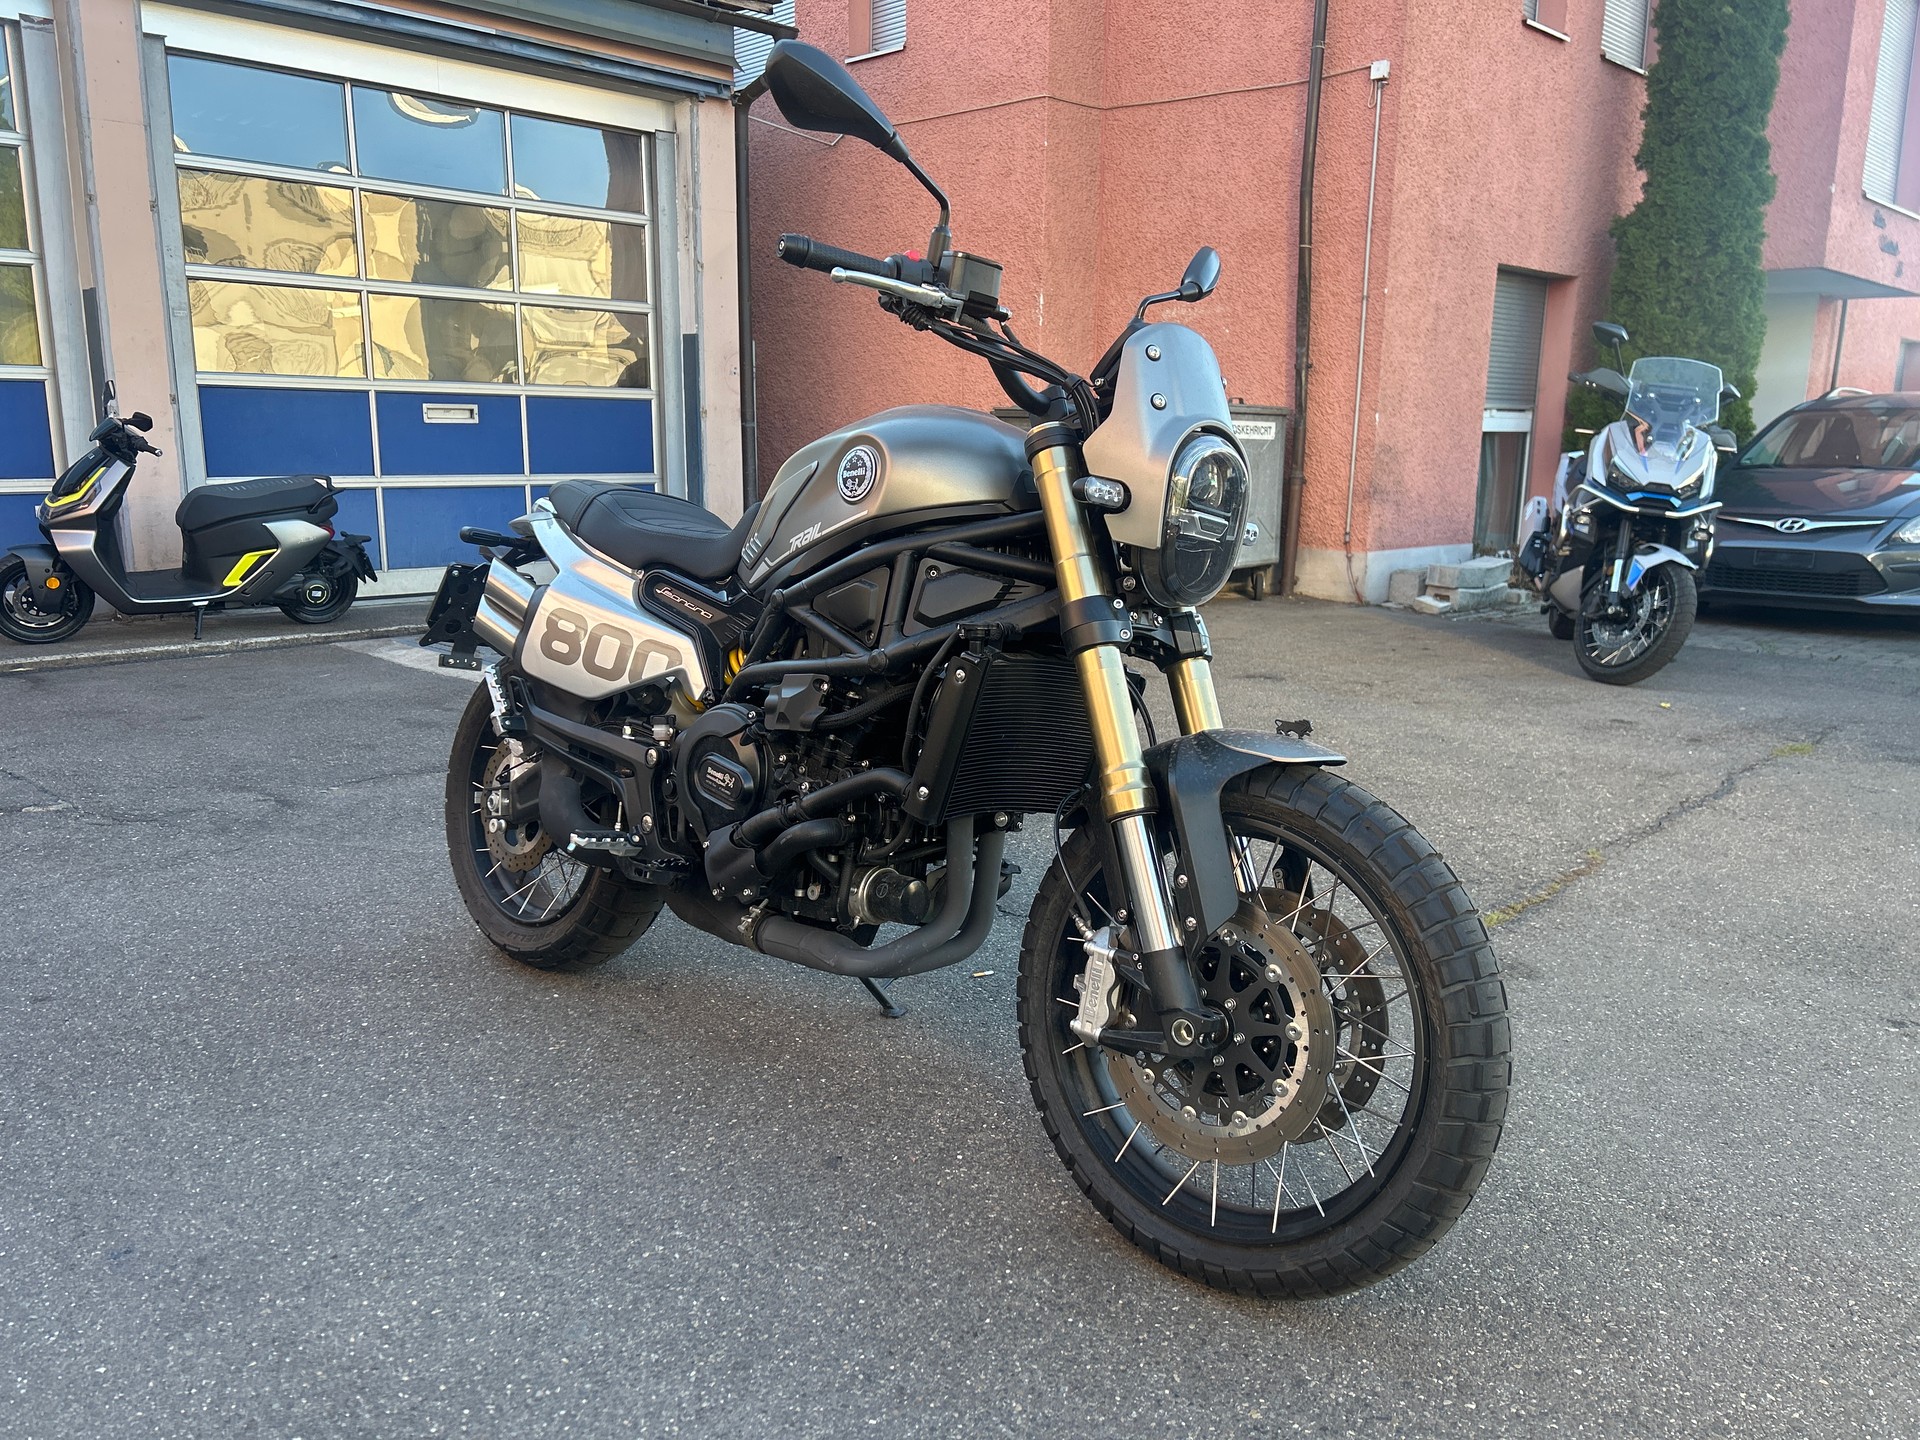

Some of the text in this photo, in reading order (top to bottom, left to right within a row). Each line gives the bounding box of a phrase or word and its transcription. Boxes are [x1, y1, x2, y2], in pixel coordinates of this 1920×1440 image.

[843, 467, 866, 479] Benelli
[540, 607, 683, 685] 800
[1084, 966, 1103, 1019] Benelli
